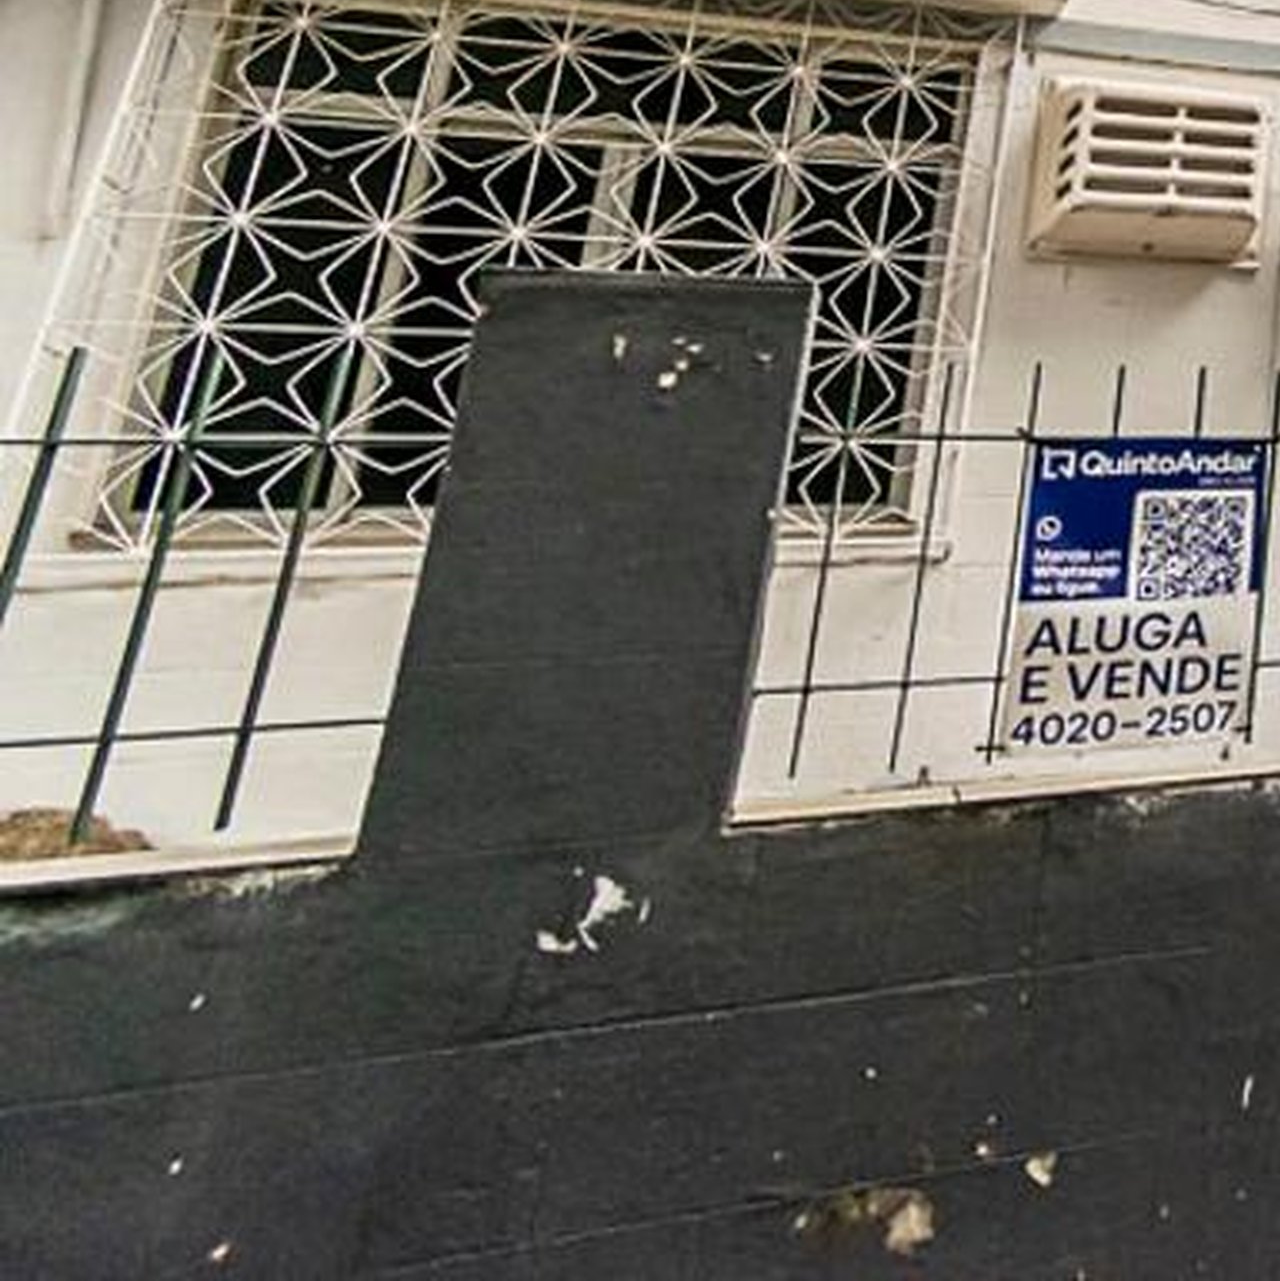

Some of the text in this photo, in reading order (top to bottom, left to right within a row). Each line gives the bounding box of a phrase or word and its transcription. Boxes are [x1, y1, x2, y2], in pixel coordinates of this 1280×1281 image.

[1080, 449, 1256, 476] QuintoAndar
[1025, 611, 1207, 657] ALUGA
[1019, 653, 1242, 704] E VENDE
[1011, 700, 1238, 745] 4020-2507
